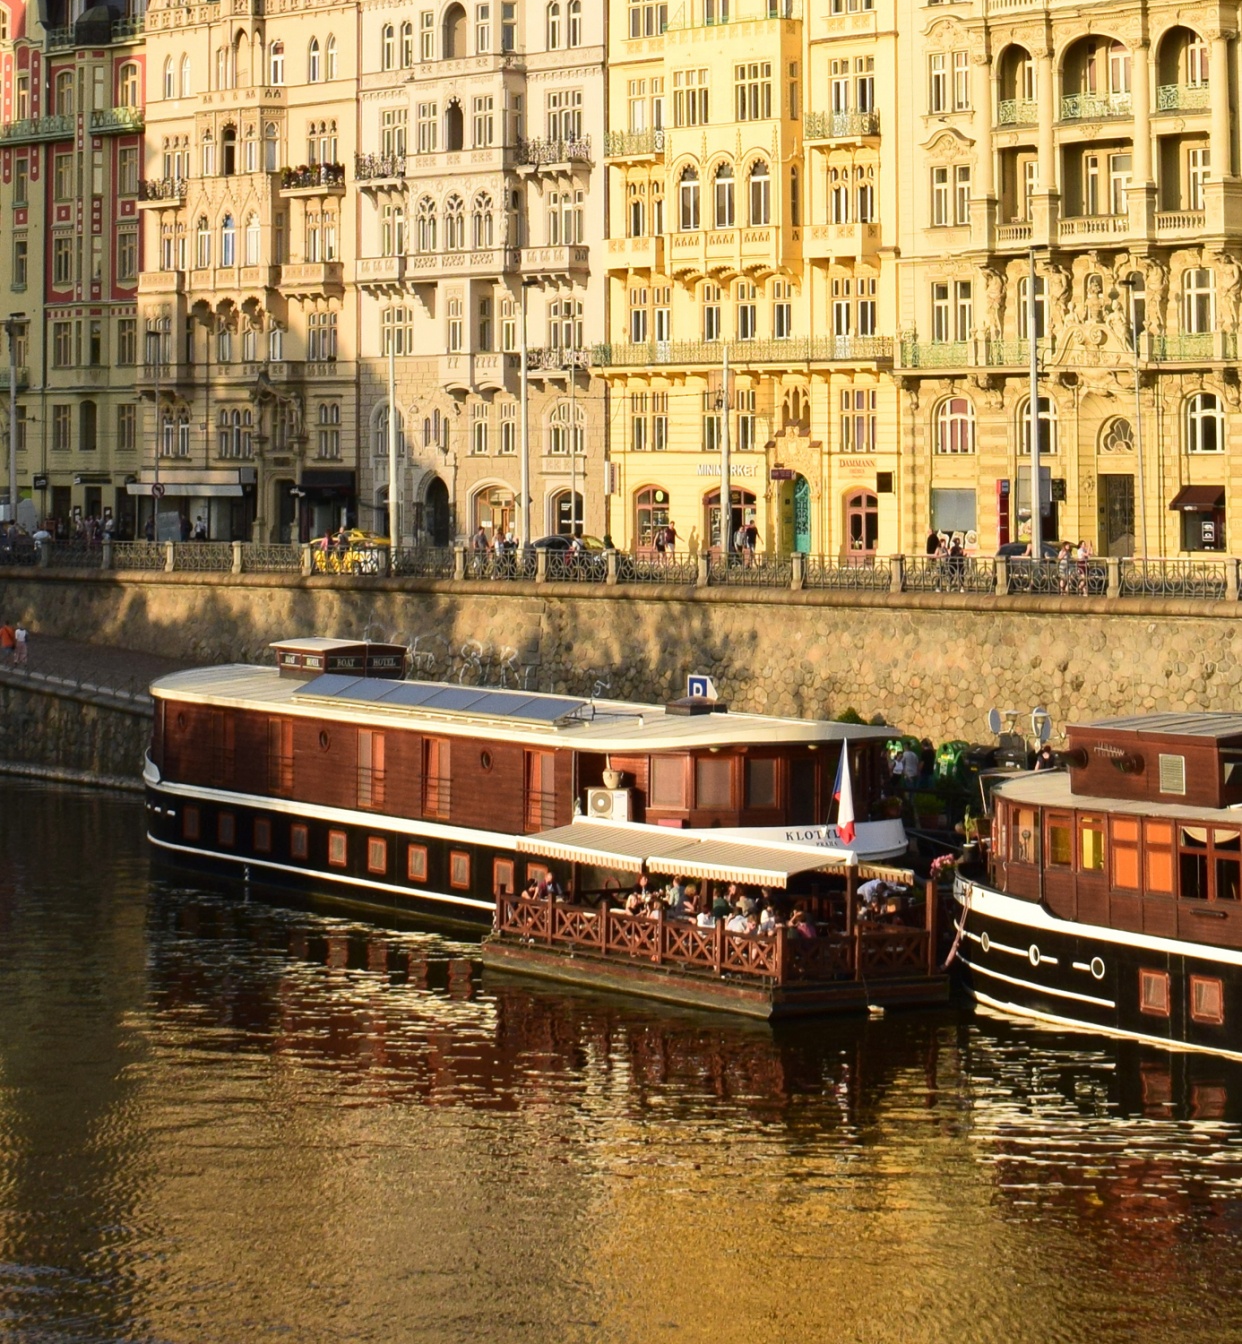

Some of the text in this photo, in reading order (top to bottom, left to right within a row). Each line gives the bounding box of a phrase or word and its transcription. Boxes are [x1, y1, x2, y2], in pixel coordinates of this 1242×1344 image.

[697, 464, 758, 476] MINIMRKET
[337, 658, 395, 667] BOAT HOTEL
[786, 829, 840, 841] KLOTYL
